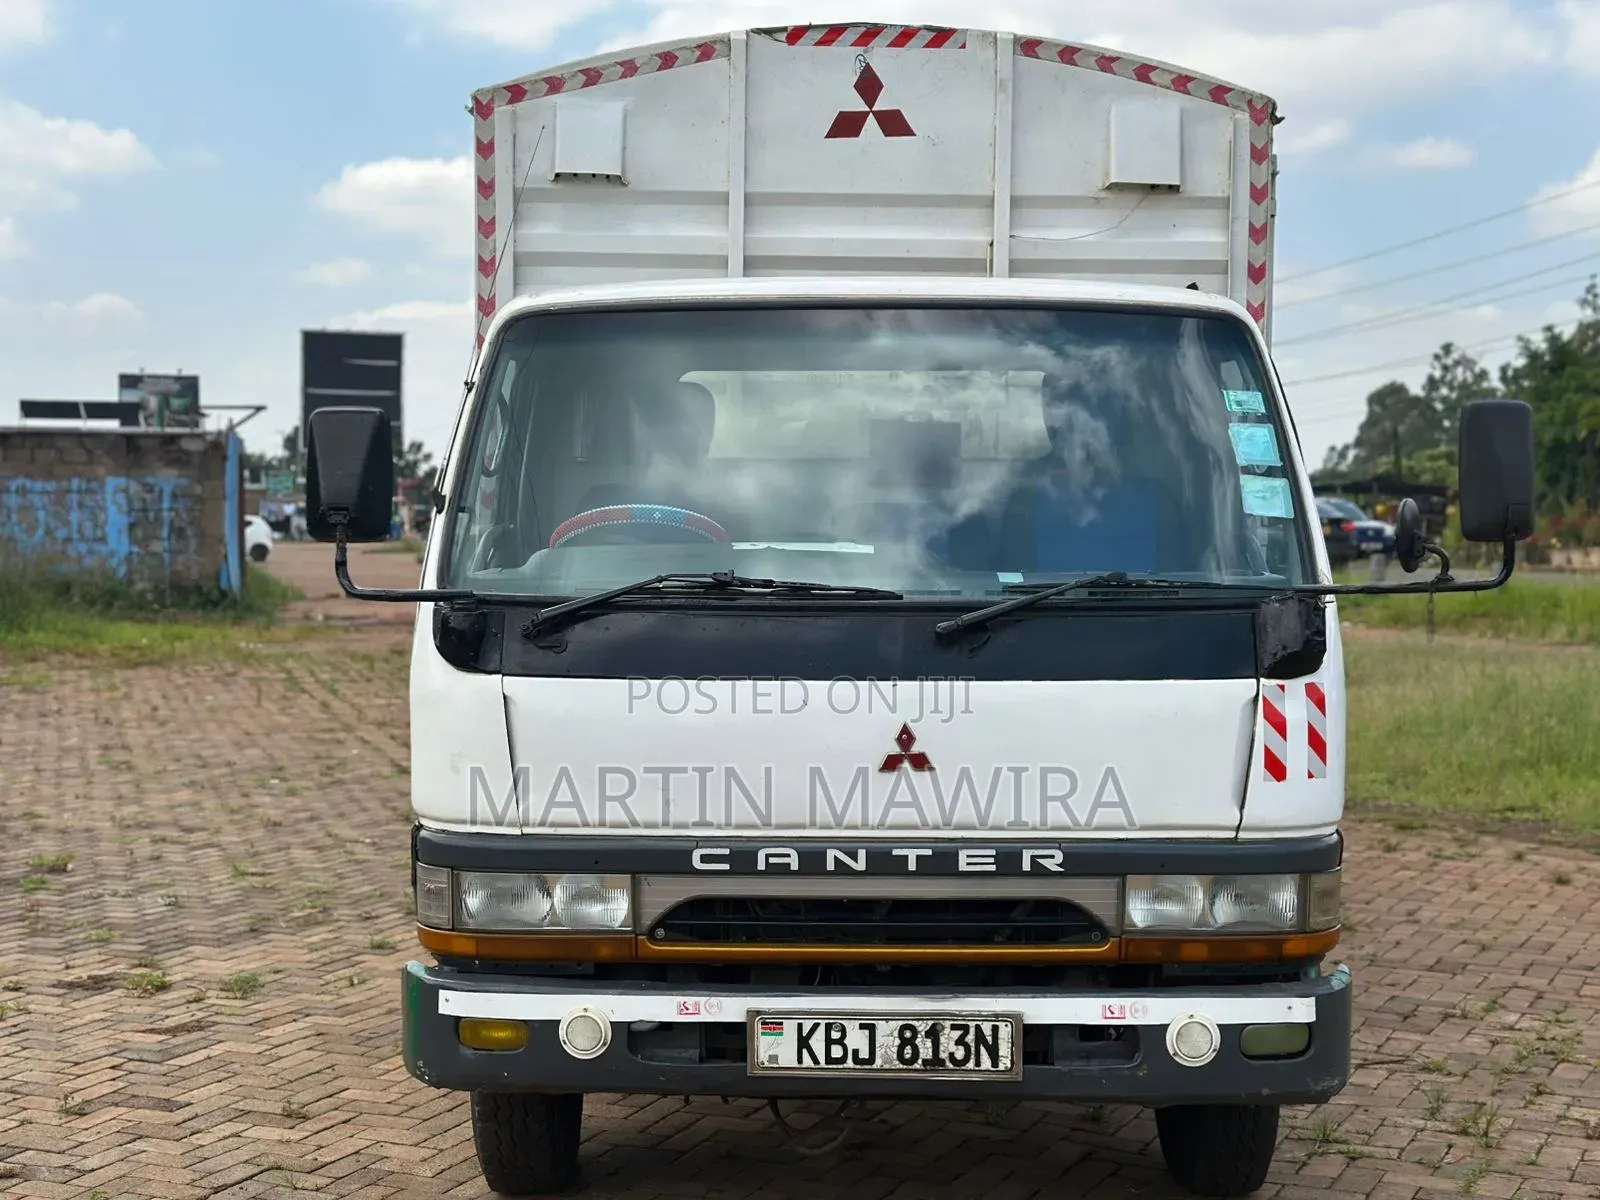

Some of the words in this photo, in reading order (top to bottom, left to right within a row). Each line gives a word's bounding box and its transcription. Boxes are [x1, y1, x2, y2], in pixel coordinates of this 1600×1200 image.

[691, 847, 1065, 872] CANTER
[797, 1022, 877, 1066] KBJ
[897, 1023, 1000, 1068] 813N
